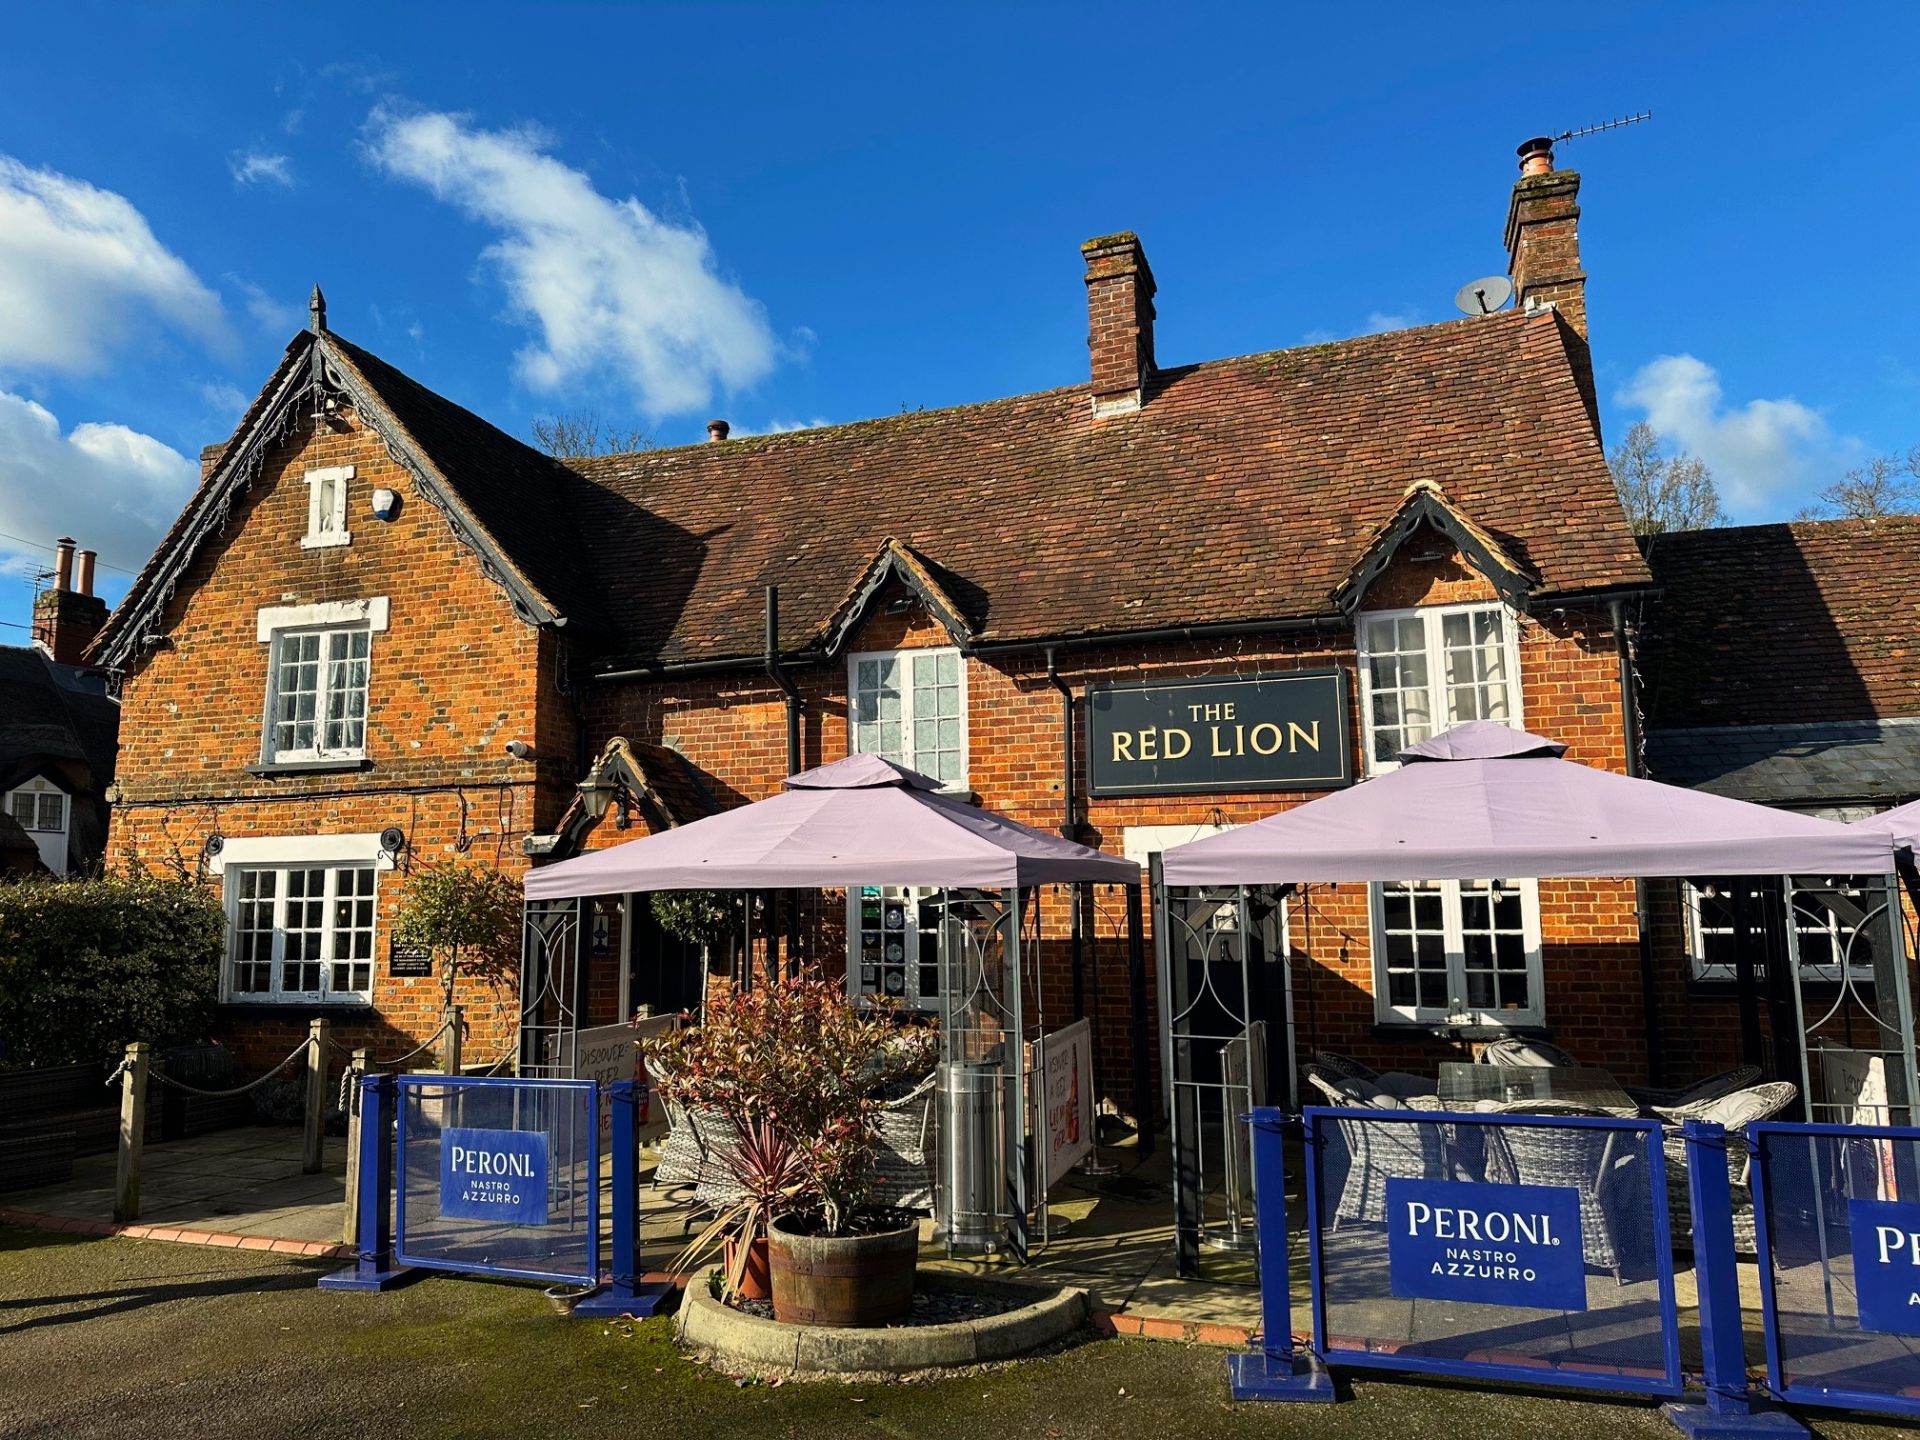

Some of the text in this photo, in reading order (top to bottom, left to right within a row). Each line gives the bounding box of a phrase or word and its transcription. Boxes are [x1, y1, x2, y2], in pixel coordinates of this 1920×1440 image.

[1187, 702, 1236, 723] THE
[1111, 720, 1320, 762] RED LION
[471, 1180, 510, 1191] NASTRO
[462, 1191, 520, 1205] AZZURRO
[1447, 1247, 1517, 1264] NASTRO
[1431, 1261, 1536, 1282] AZZURRO
